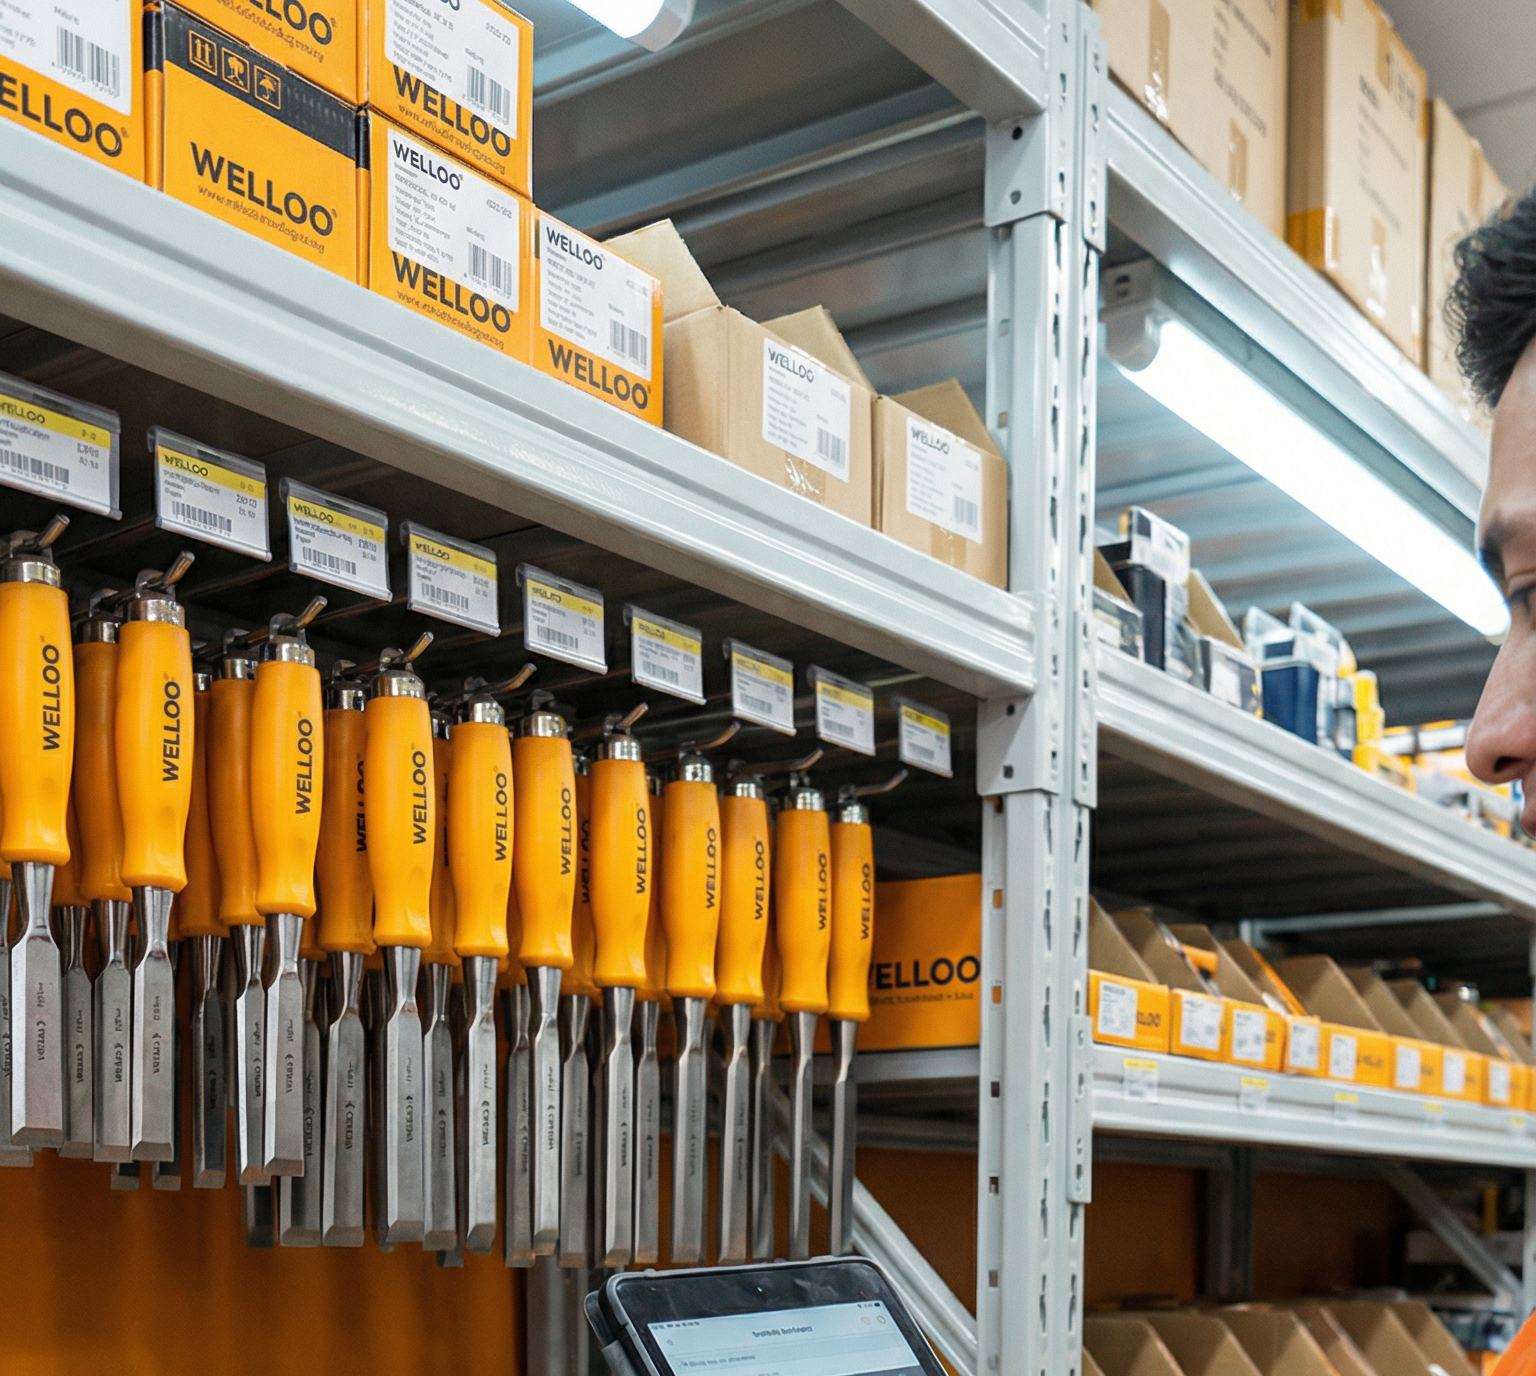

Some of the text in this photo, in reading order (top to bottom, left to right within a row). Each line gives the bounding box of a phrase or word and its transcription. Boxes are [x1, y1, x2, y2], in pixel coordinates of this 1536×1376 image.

[248, 0, 332, 45] LOO
[0, 72, 123, 157] ELLOO
[393, 64, 511, 157] WELLOO
[190, 142, 333, 236] WELLOO
[393, 139, 461, 190] WELLOO
[546, 227, 603, 270] WELLOO
[392, 250, 511, 333] WELLOO
[547, 339, 648, 409] WELLOO
[42, 644, 60, 751] WELLOO
[163, 682, 181, 782] WELLOO
[296, 719, 313, 814] WELLOO
[413, 751, 427, 844] WELLOO
[495, 774, 507, 861] WELLOO
[561, 788, 572, 875] WELLOO
[636, 808, 647, 894] WELLOO
[706, 828, 717, 909] WELLOO
[755, 841, 765, 920] WELLOO
[818, 853, 828, 931] WELLOO
[861, 863, 871, 940] WELLOO
[869, 956, 981, 990] ELLOO
